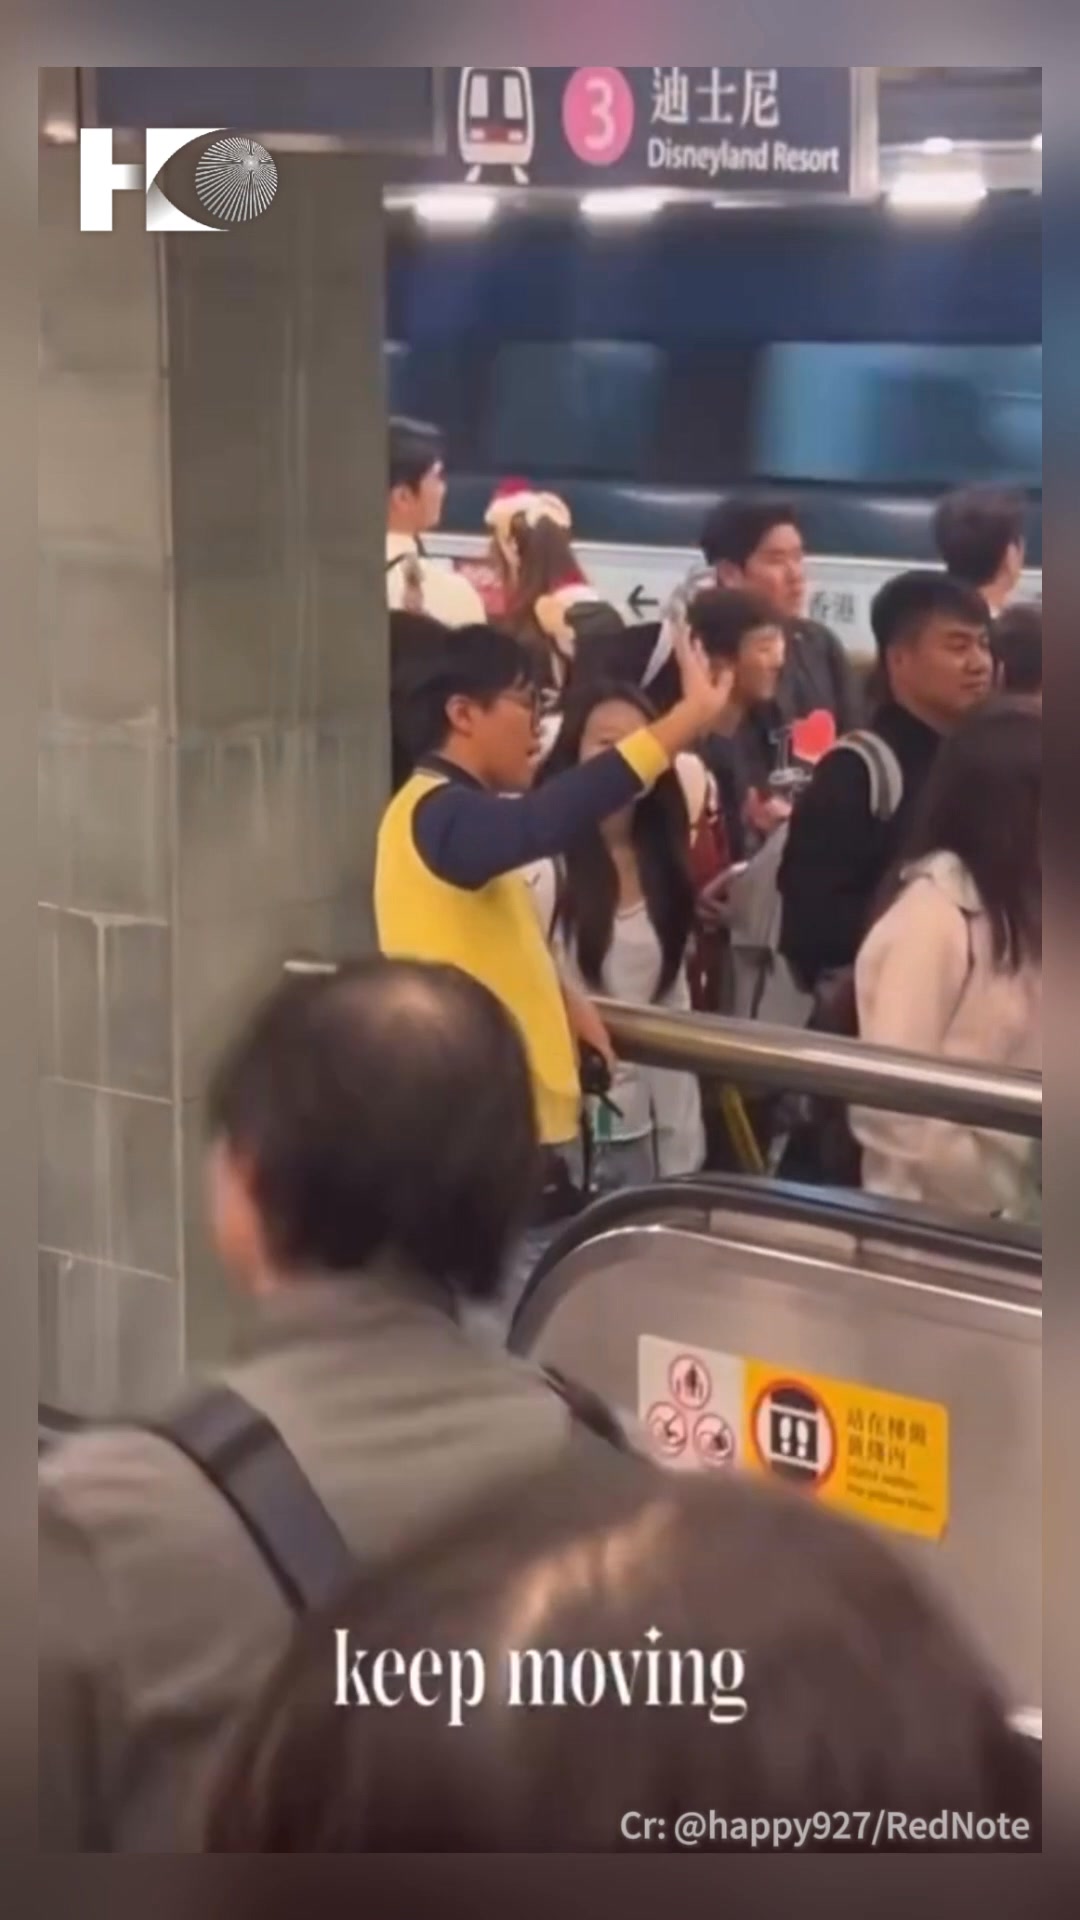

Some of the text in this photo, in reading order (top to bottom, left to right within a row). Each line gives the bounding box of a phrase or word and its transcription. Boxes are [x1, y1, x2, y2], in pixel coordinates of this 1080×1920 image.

[584, 78, 615, 150] 3
[651, 67, 780, 127] 迪士尼
[647, 137, 840, 176] Disneyland Resort
